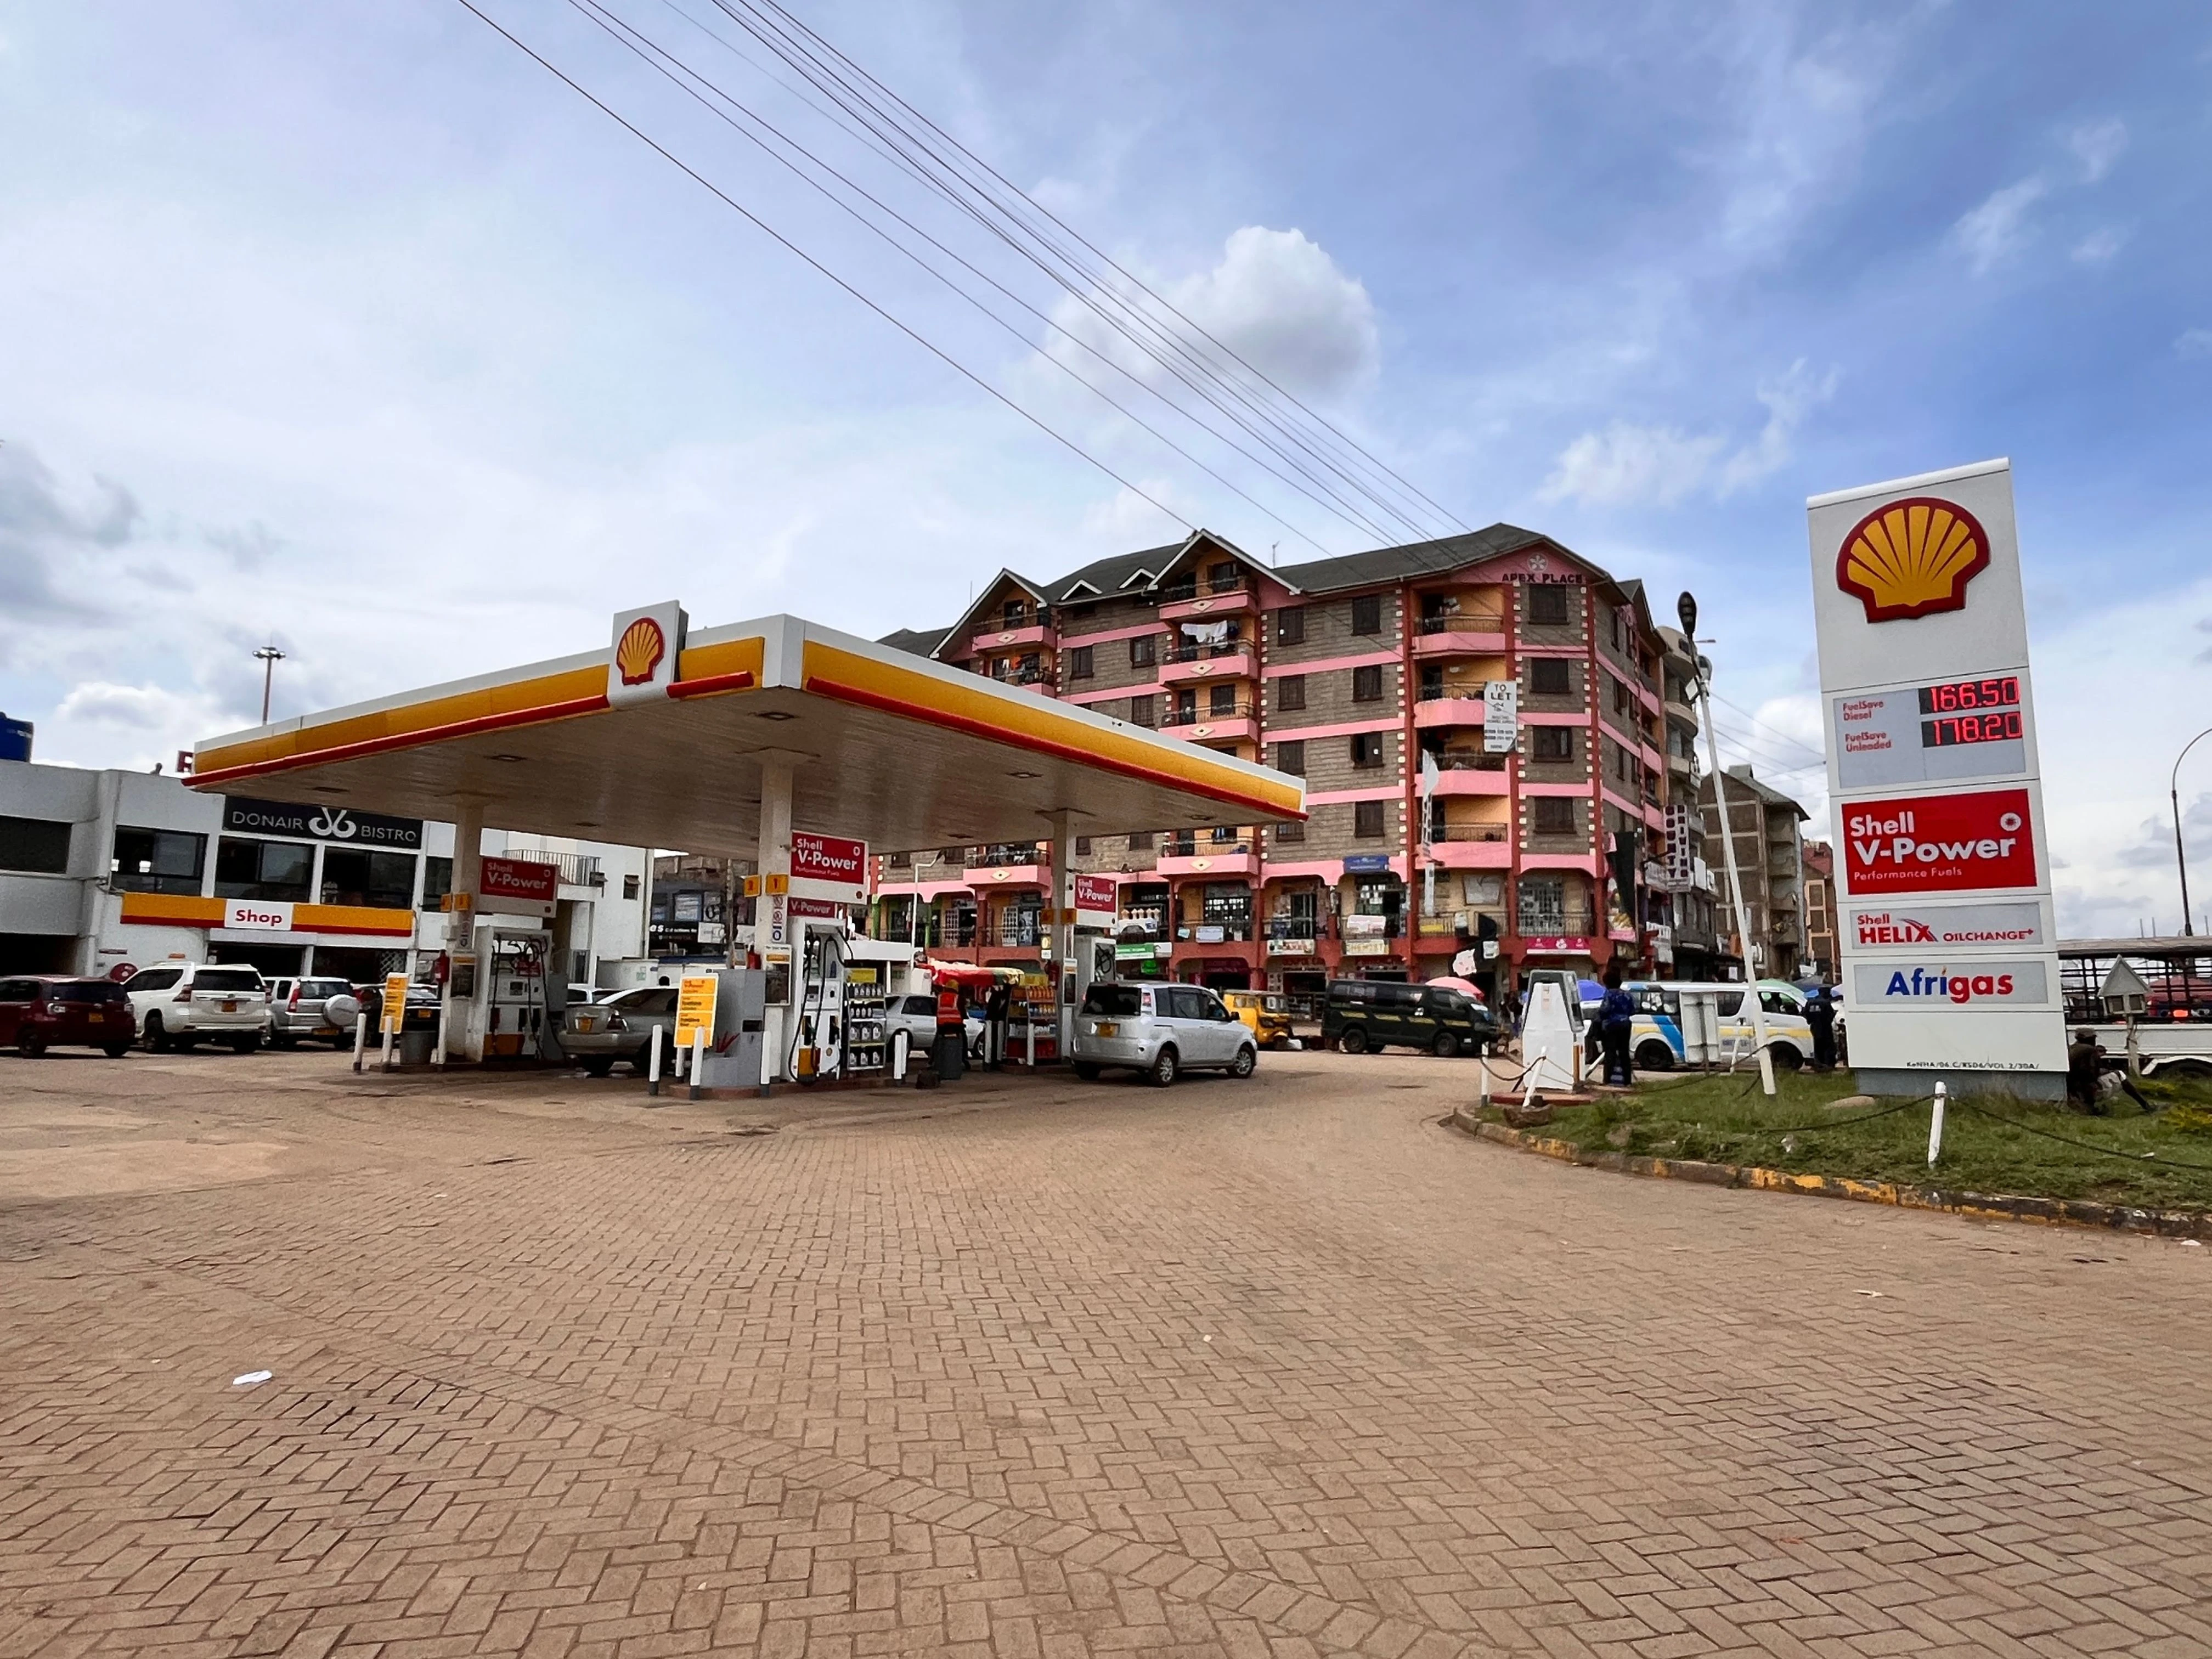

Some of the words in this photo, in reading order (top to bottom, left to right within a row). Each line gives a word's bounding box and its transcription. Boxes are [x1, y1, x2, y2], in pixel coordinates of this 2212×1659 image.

[1502, 573, 1535, 583] APEX
[1542, 573, 1583, 583] PLACE
[1843, 700, 1883, 711] FuelSave
[1931, 679, 2020, 712] 166.50
[1843, 710, 1872, 721] Diesel
[1845, 731, 1886, 742] FuelSave
[1934, 713, 2022, 745] 178.20
[1846, 740, 1892, 752] Unleaded
[233, 811, 303, 830] DONAIR
[361, 825, 416, 842] BISTRO
[1850, 811, 1915, 837] Shell
[797, 838, 823, 851] Shell
[1853, 837, 2016, 866] V-Power
[487, 862, 513, 873] Shell
[798, 849, 857, 871] V-Power
[487, 871, 548, 889] V-Power
[1854, 870, 1927, 881] Performance
[1931, 866, 1962, 877] Fuels
[1078, 887, 1112, 902] V-Power
[791, 900, 831, 913] V-Power
[235, 909, 283, 926] Shop
[1858, 913, 1890, 925] Shell
[1858, 926, 1937, 944] HELIX
[1943, 931, 2025, 942] OILCHANGE
[1885, 967, 2013, 1004] Afrigas
